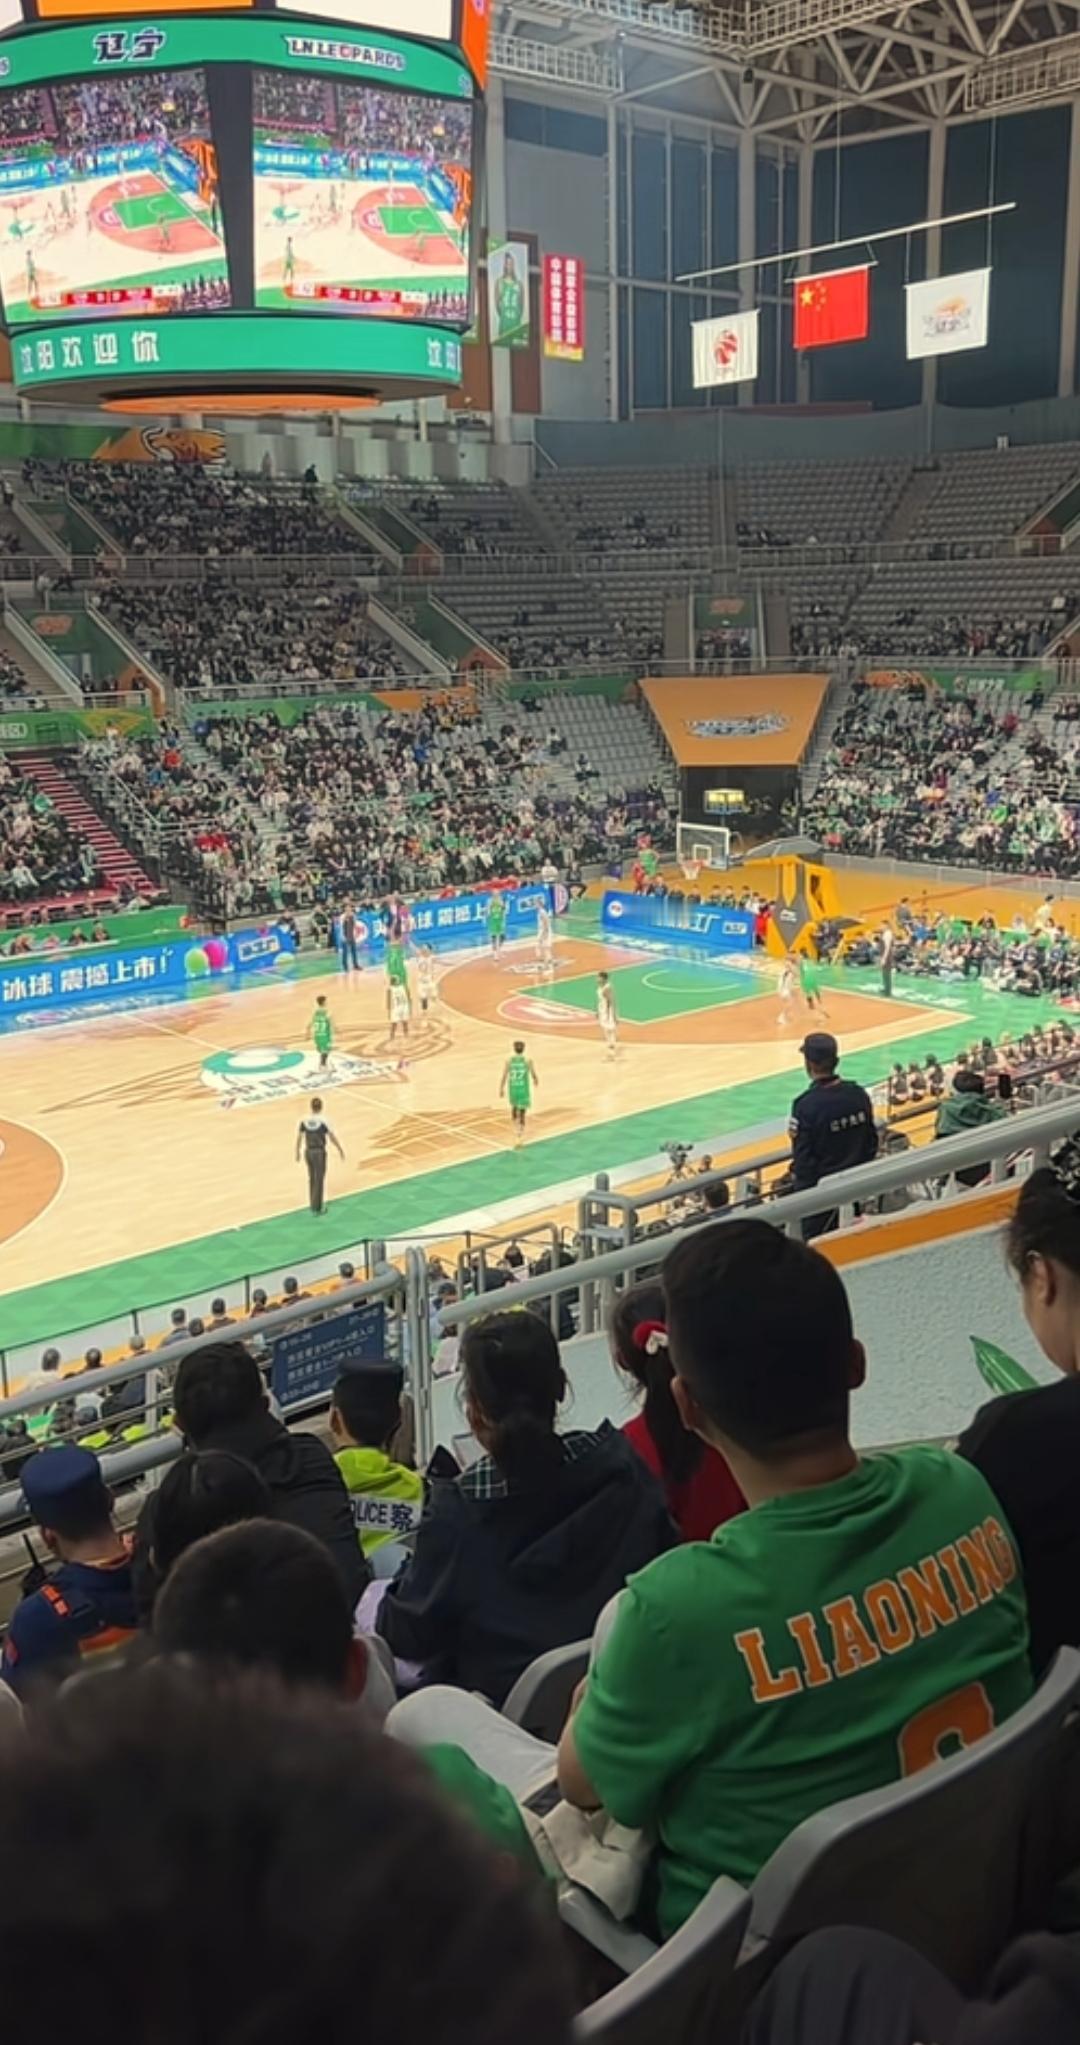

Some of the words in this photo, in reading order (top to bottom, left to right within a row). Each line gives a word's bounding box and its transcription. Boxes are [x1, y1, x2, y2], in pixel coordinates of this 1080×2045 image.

[93, 26, 166, 63] 辽宁
[290, 38, 314, 55] LN
[316, 41, 406, 70] LEOPARDS
[20, 331, 160, 374] 沈阳欢迎你
[427, 337, 462, 373] 沈阳
[3, 972, 53, 1001] 冰球
[733, 1515, 1017, 1704] LIAONING
